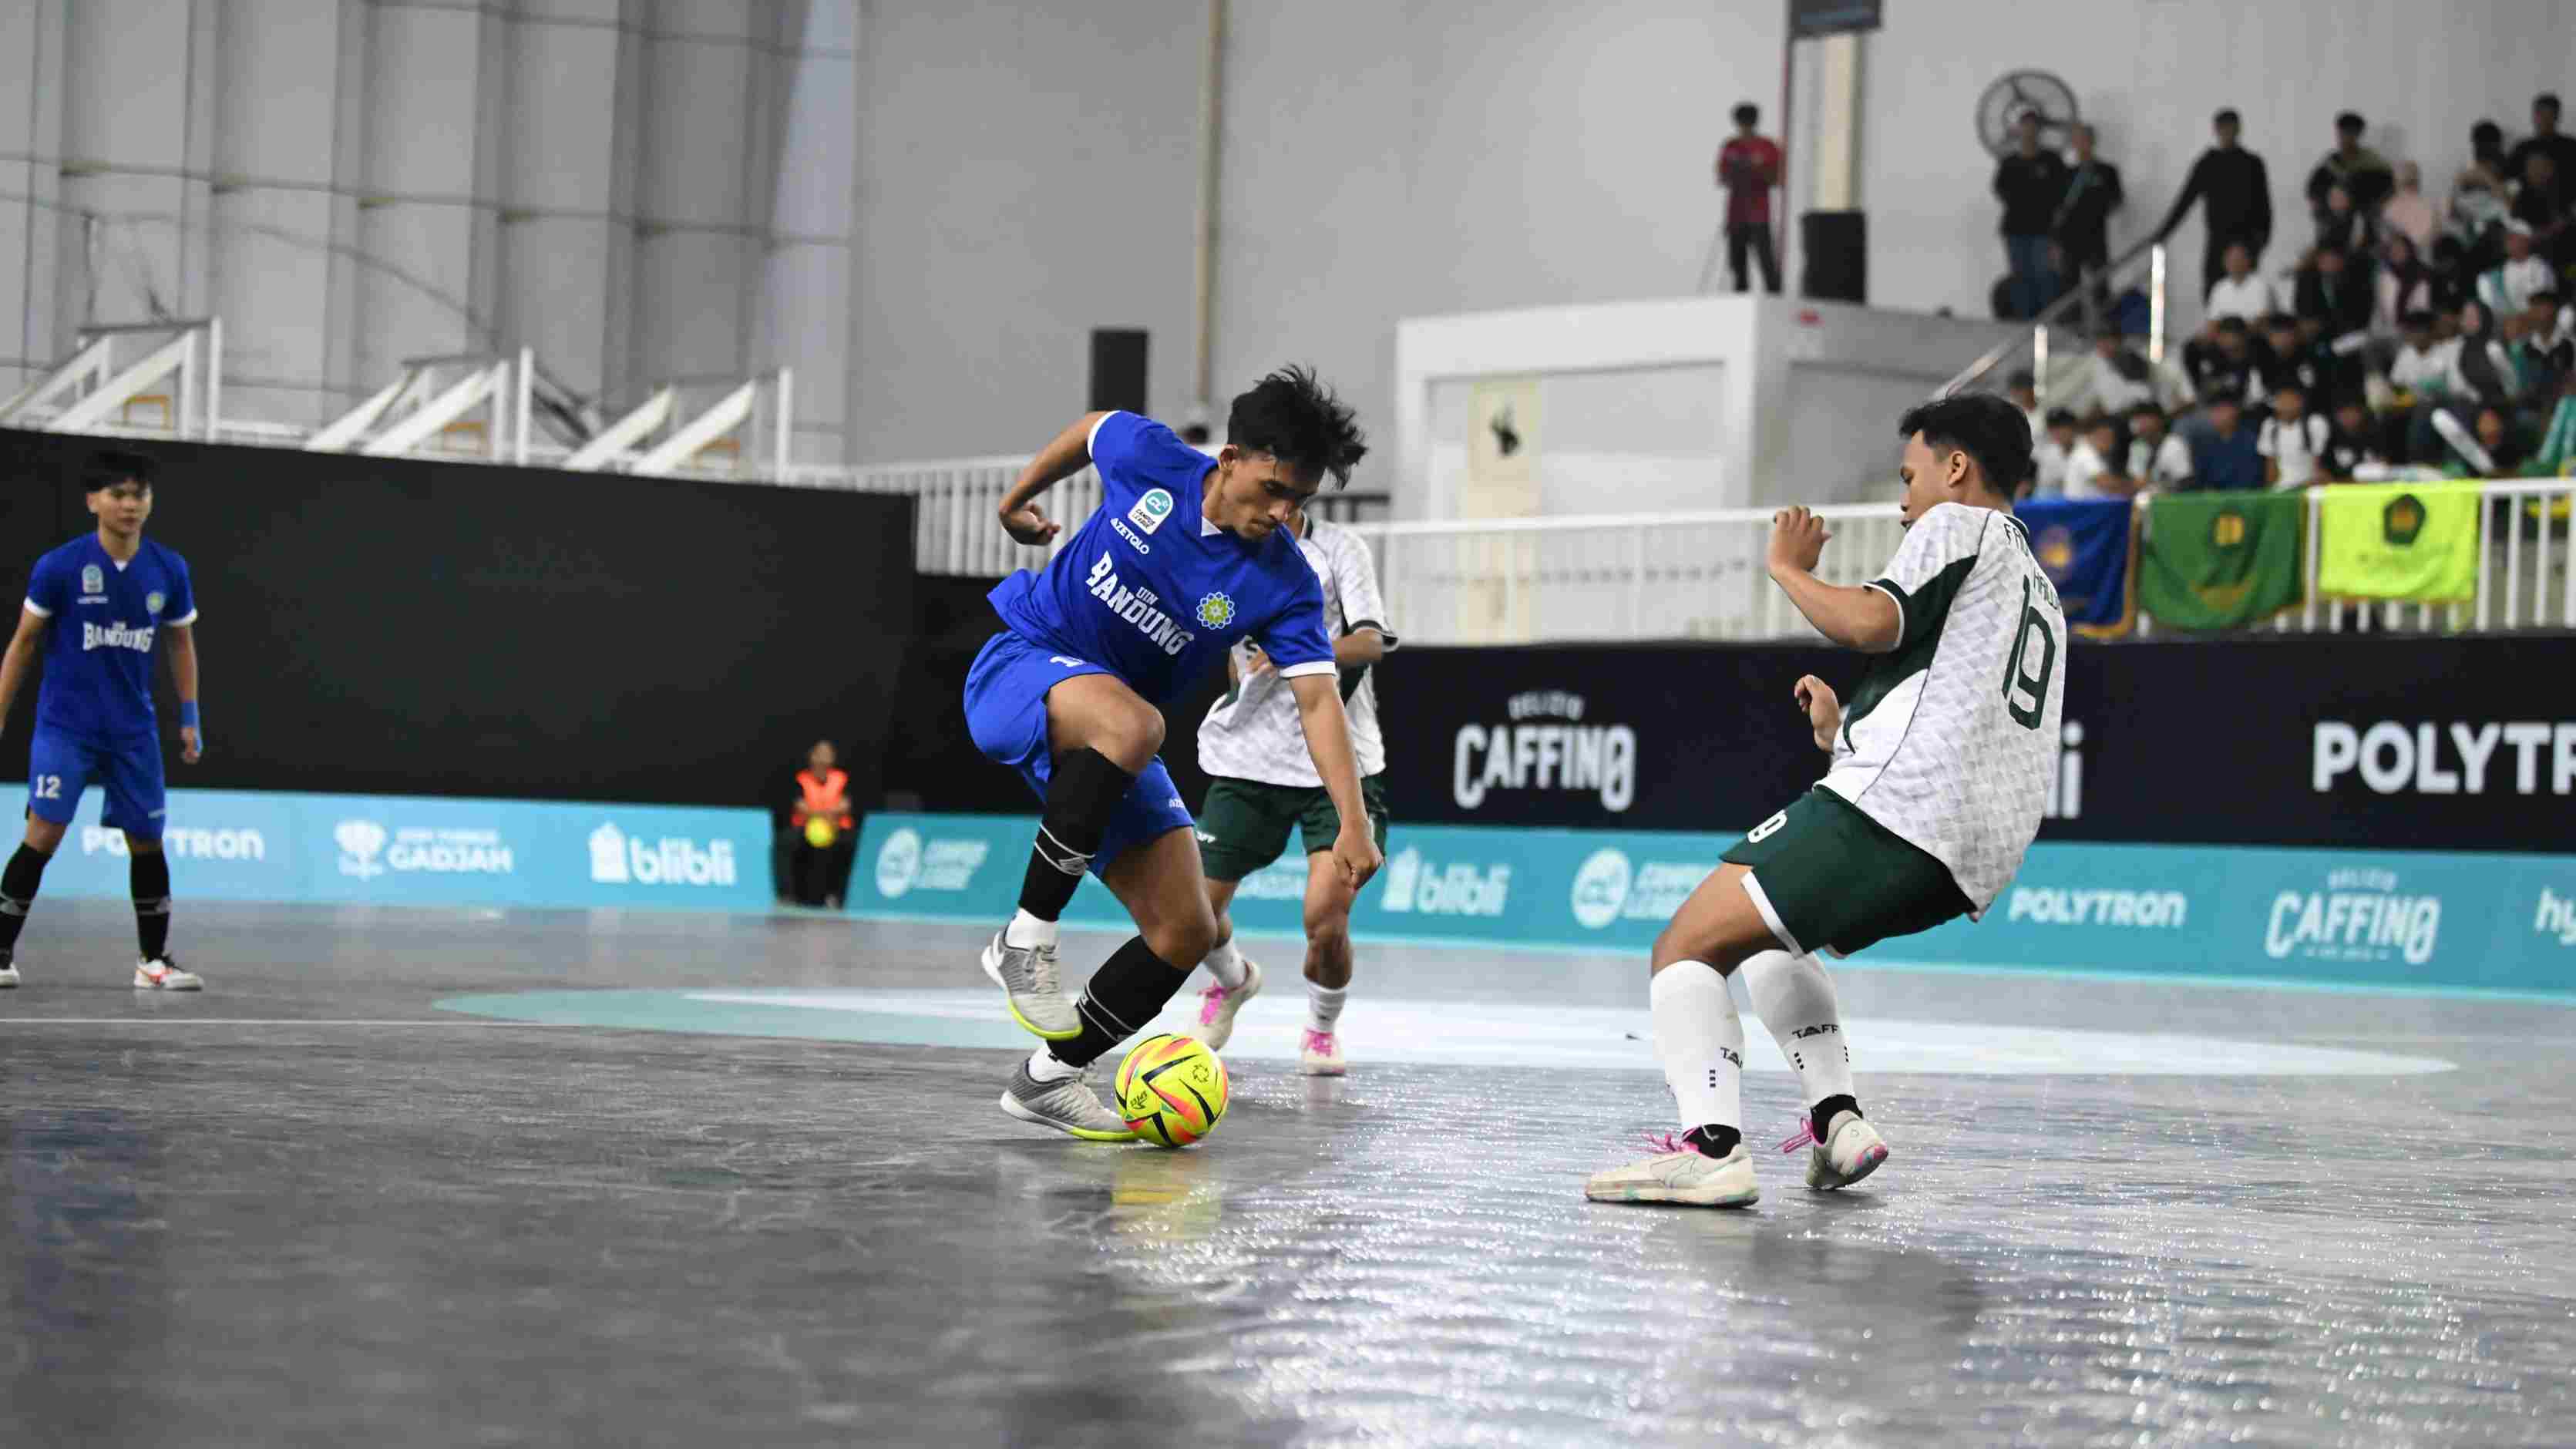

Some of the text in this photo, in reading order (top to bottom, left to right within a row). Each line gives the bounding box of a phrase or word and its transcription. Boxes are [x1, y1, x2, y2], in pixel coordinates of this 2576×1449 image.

[1085, 550, 1195, 655] BANDUNG
[1135, 587, 1159, 605] UIN
[82, 620, 155, 653] BANDUNG
[2002, 574, 2056, 731] 19
[35, 775, 60, 799] 12
[1453, 723, 1636, 812] CAFFINO
[82, 825, 265, 861] POTRON
[630, 836, 737, 886] blibli
[1417, 862, 1512, 916] blibli
[2008, 886, 2187, 928] POLYTRON
[2265, 889, 2441, 964] CAFFINO
